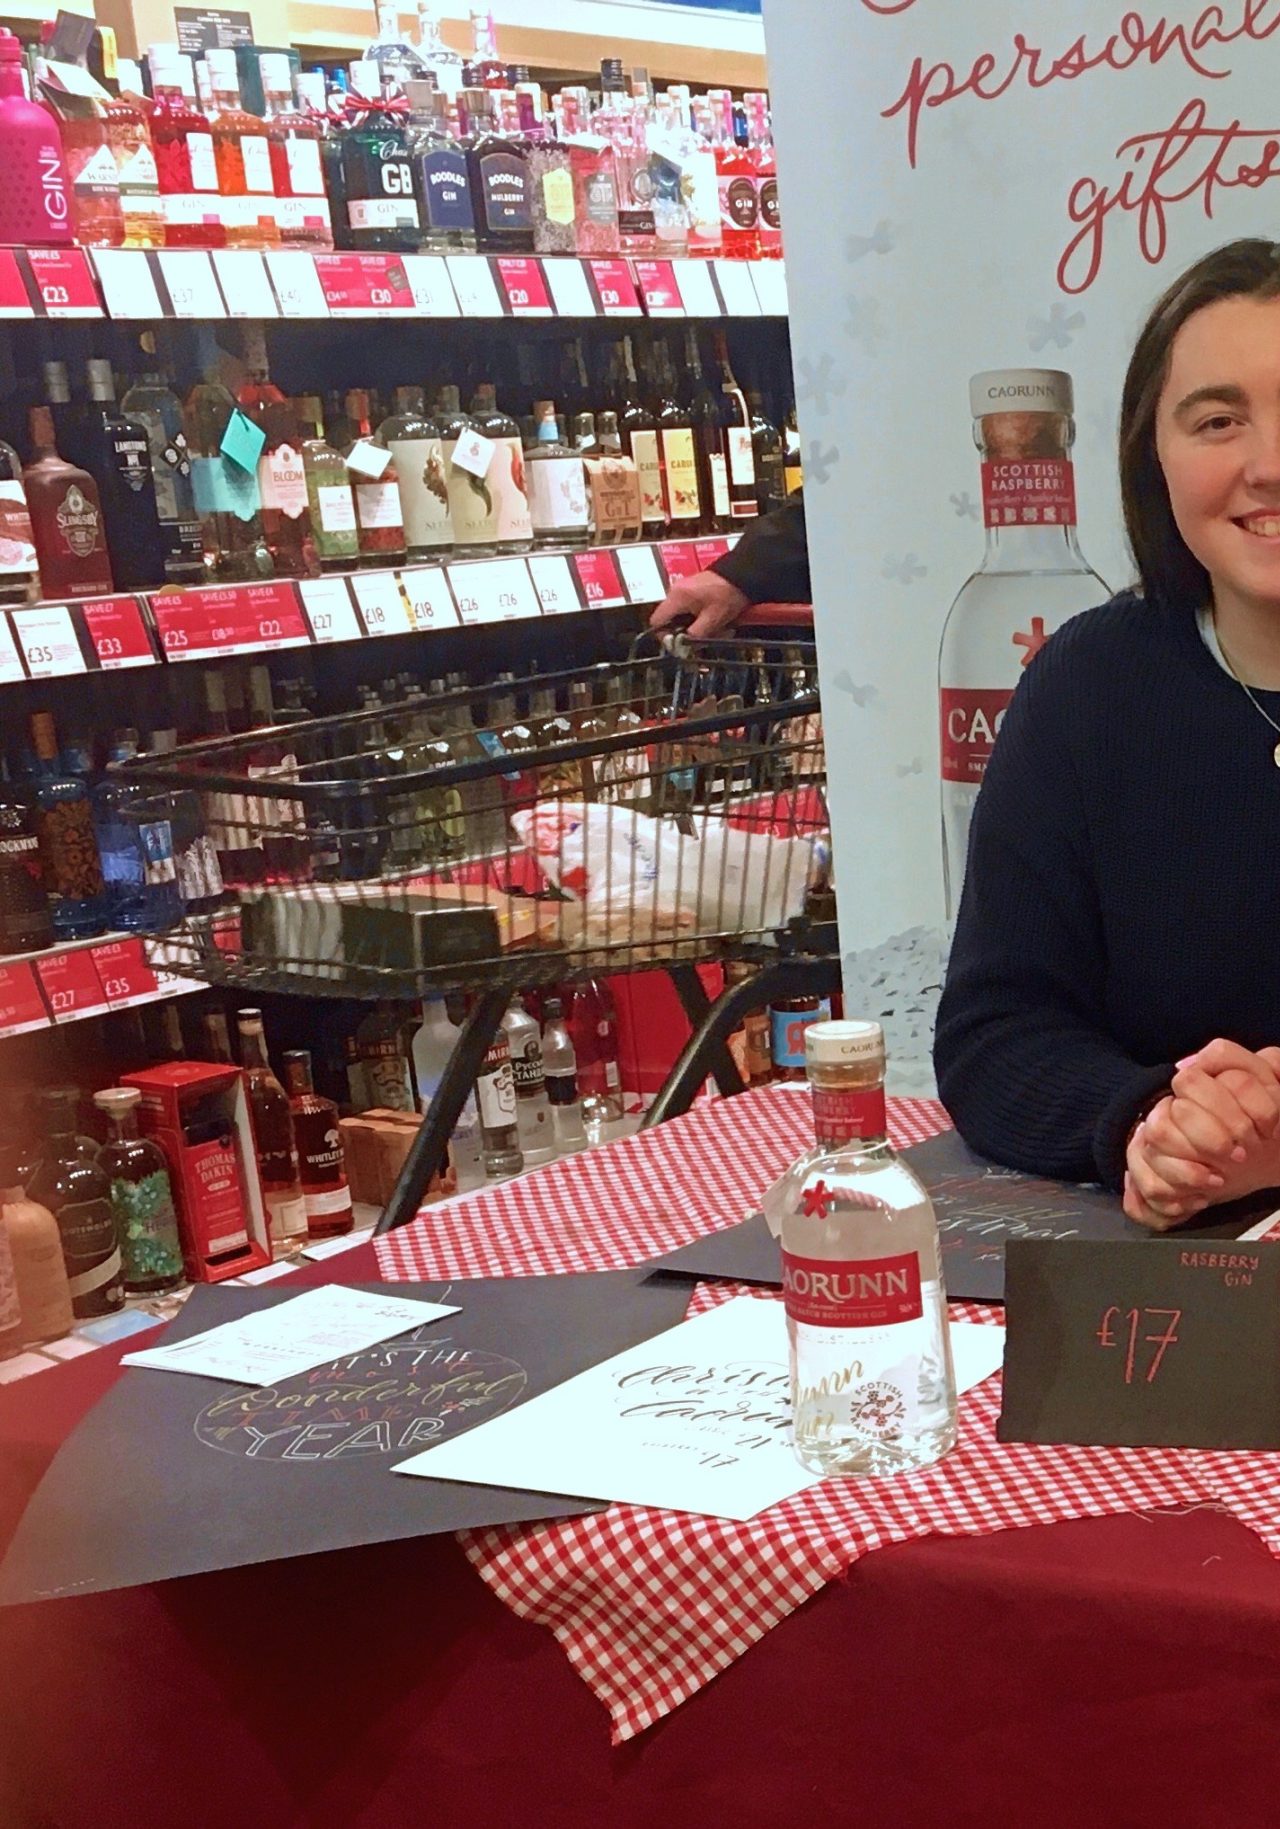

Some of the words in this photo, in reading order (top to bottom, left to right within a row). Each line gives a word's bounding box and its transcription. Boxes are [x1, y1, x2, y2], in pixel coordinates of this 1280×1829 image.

[381, 164, 413, 194] GB
[430, 171, 466, 187] BOODLES
[488, 173, 524, 188] BOODLES
[38, 159, 67, 220] GIN
[442, 191, 457, 201] GIN
[735, 199, 753, 208] GIN
[43, 286, 69, 302] £23
[988, 385, 1055, 399] CAORUNN
[273, 471, 304, 482] BLOOM
[993, 464, 1063, 478] SCOTTISH
[991, 478, 1065, 491] RASPBERRY
[585, 583, 604, 598] £16
[414, 602, 434, 619] £18
[460, 598, 479, 612] £26
[313, 614, 332, 629] £27
[365, 607, 385, 624] £18
[259, 621, 283, 636] £22
[97, 638, 122, 655] £33
[164, 630, 188, 647] £25
[27, 646, 53, 664] £35
[105, 978, 130, 997] £35
[51, 990, 75, 1009] £27
[195, 1153, 236, 1173] THOMAS
[1180, 1252, 1259, 1269] RASBERRY
[1096, 1306, 1182, 1384] £17
[412, 1349, 473, 1366] THE
[855, 1381, 903, 1399] SCOTTISH
[243, 1417, 445, 1460] YEAR
